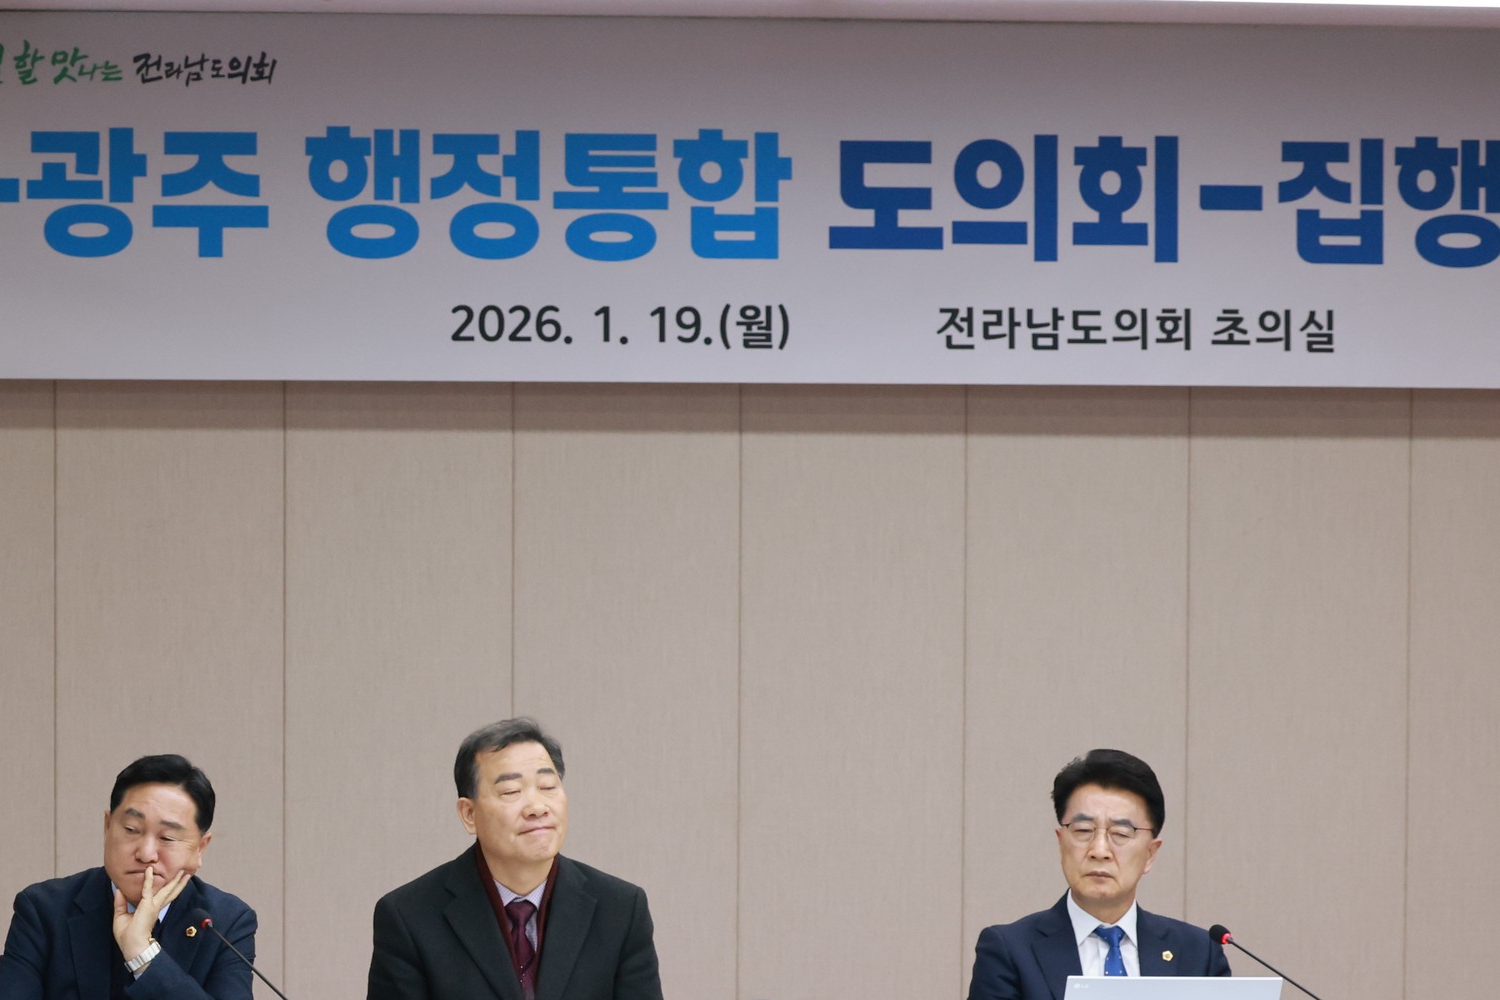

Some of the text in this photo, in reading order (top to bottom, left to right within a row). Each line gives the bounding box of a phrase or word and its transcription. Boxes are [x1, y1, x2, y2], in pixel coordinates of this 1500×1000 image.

[133, 50, 277, 88] 전라남도의회
[305, 125, 793, 262] 행정통합
[451, 303, 790, 351] 2026. 1. 19.(월)
[936, 306, 1336, 354] 전라남도의회 초의실
